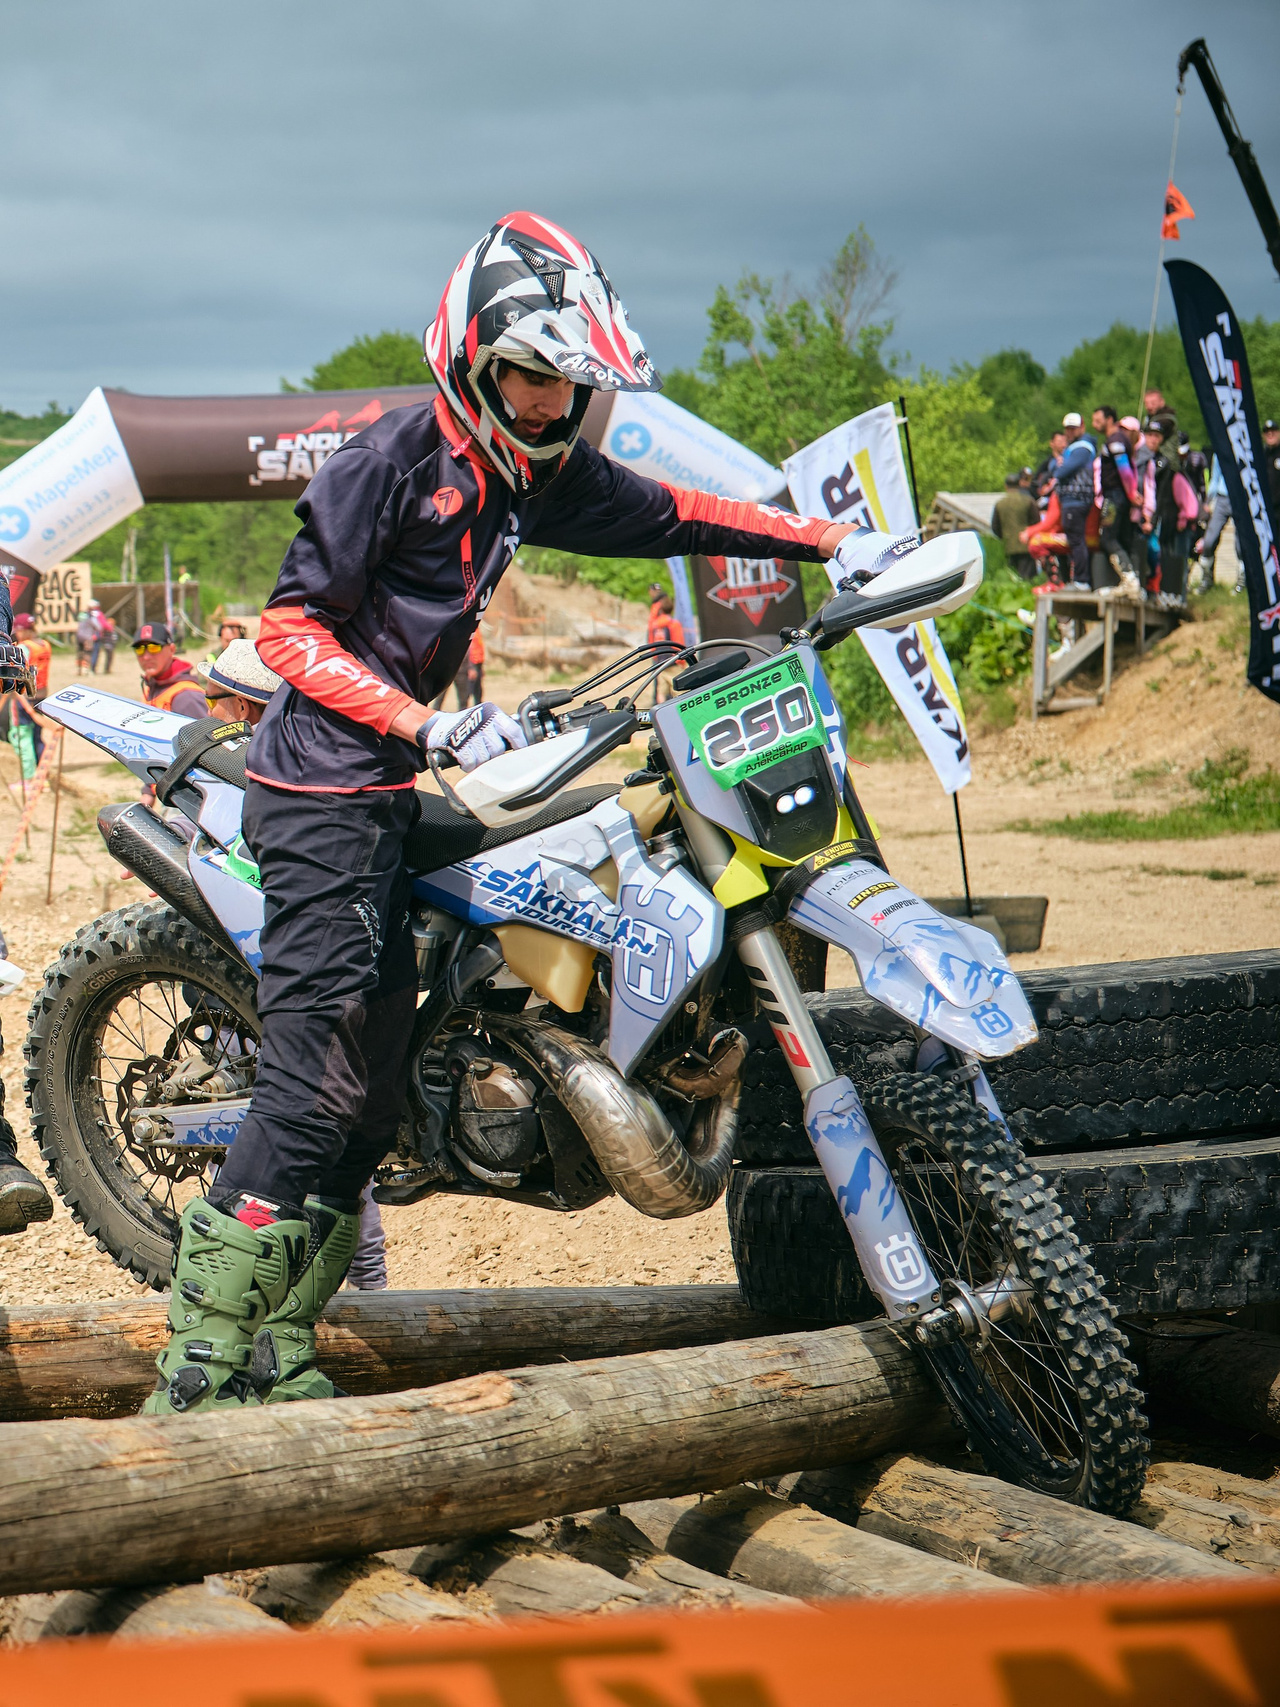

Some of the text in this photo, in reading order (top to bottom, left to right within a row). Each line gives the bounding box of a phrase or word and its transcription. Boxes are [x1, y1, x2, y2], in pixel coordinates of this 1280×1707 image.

[559, 353, 622, 387] Airoh
[34, 595, 81, 625] RUN
[714, 671, 783, 710] BRONZE
[700, 682, 817, 771] 250
[745, 741, 808, 774] Александр
[755, 741, 792, 761] Пачес
[848, 881, 899, 910] HINSON
[489, 895, 588, 937] ENDURO
